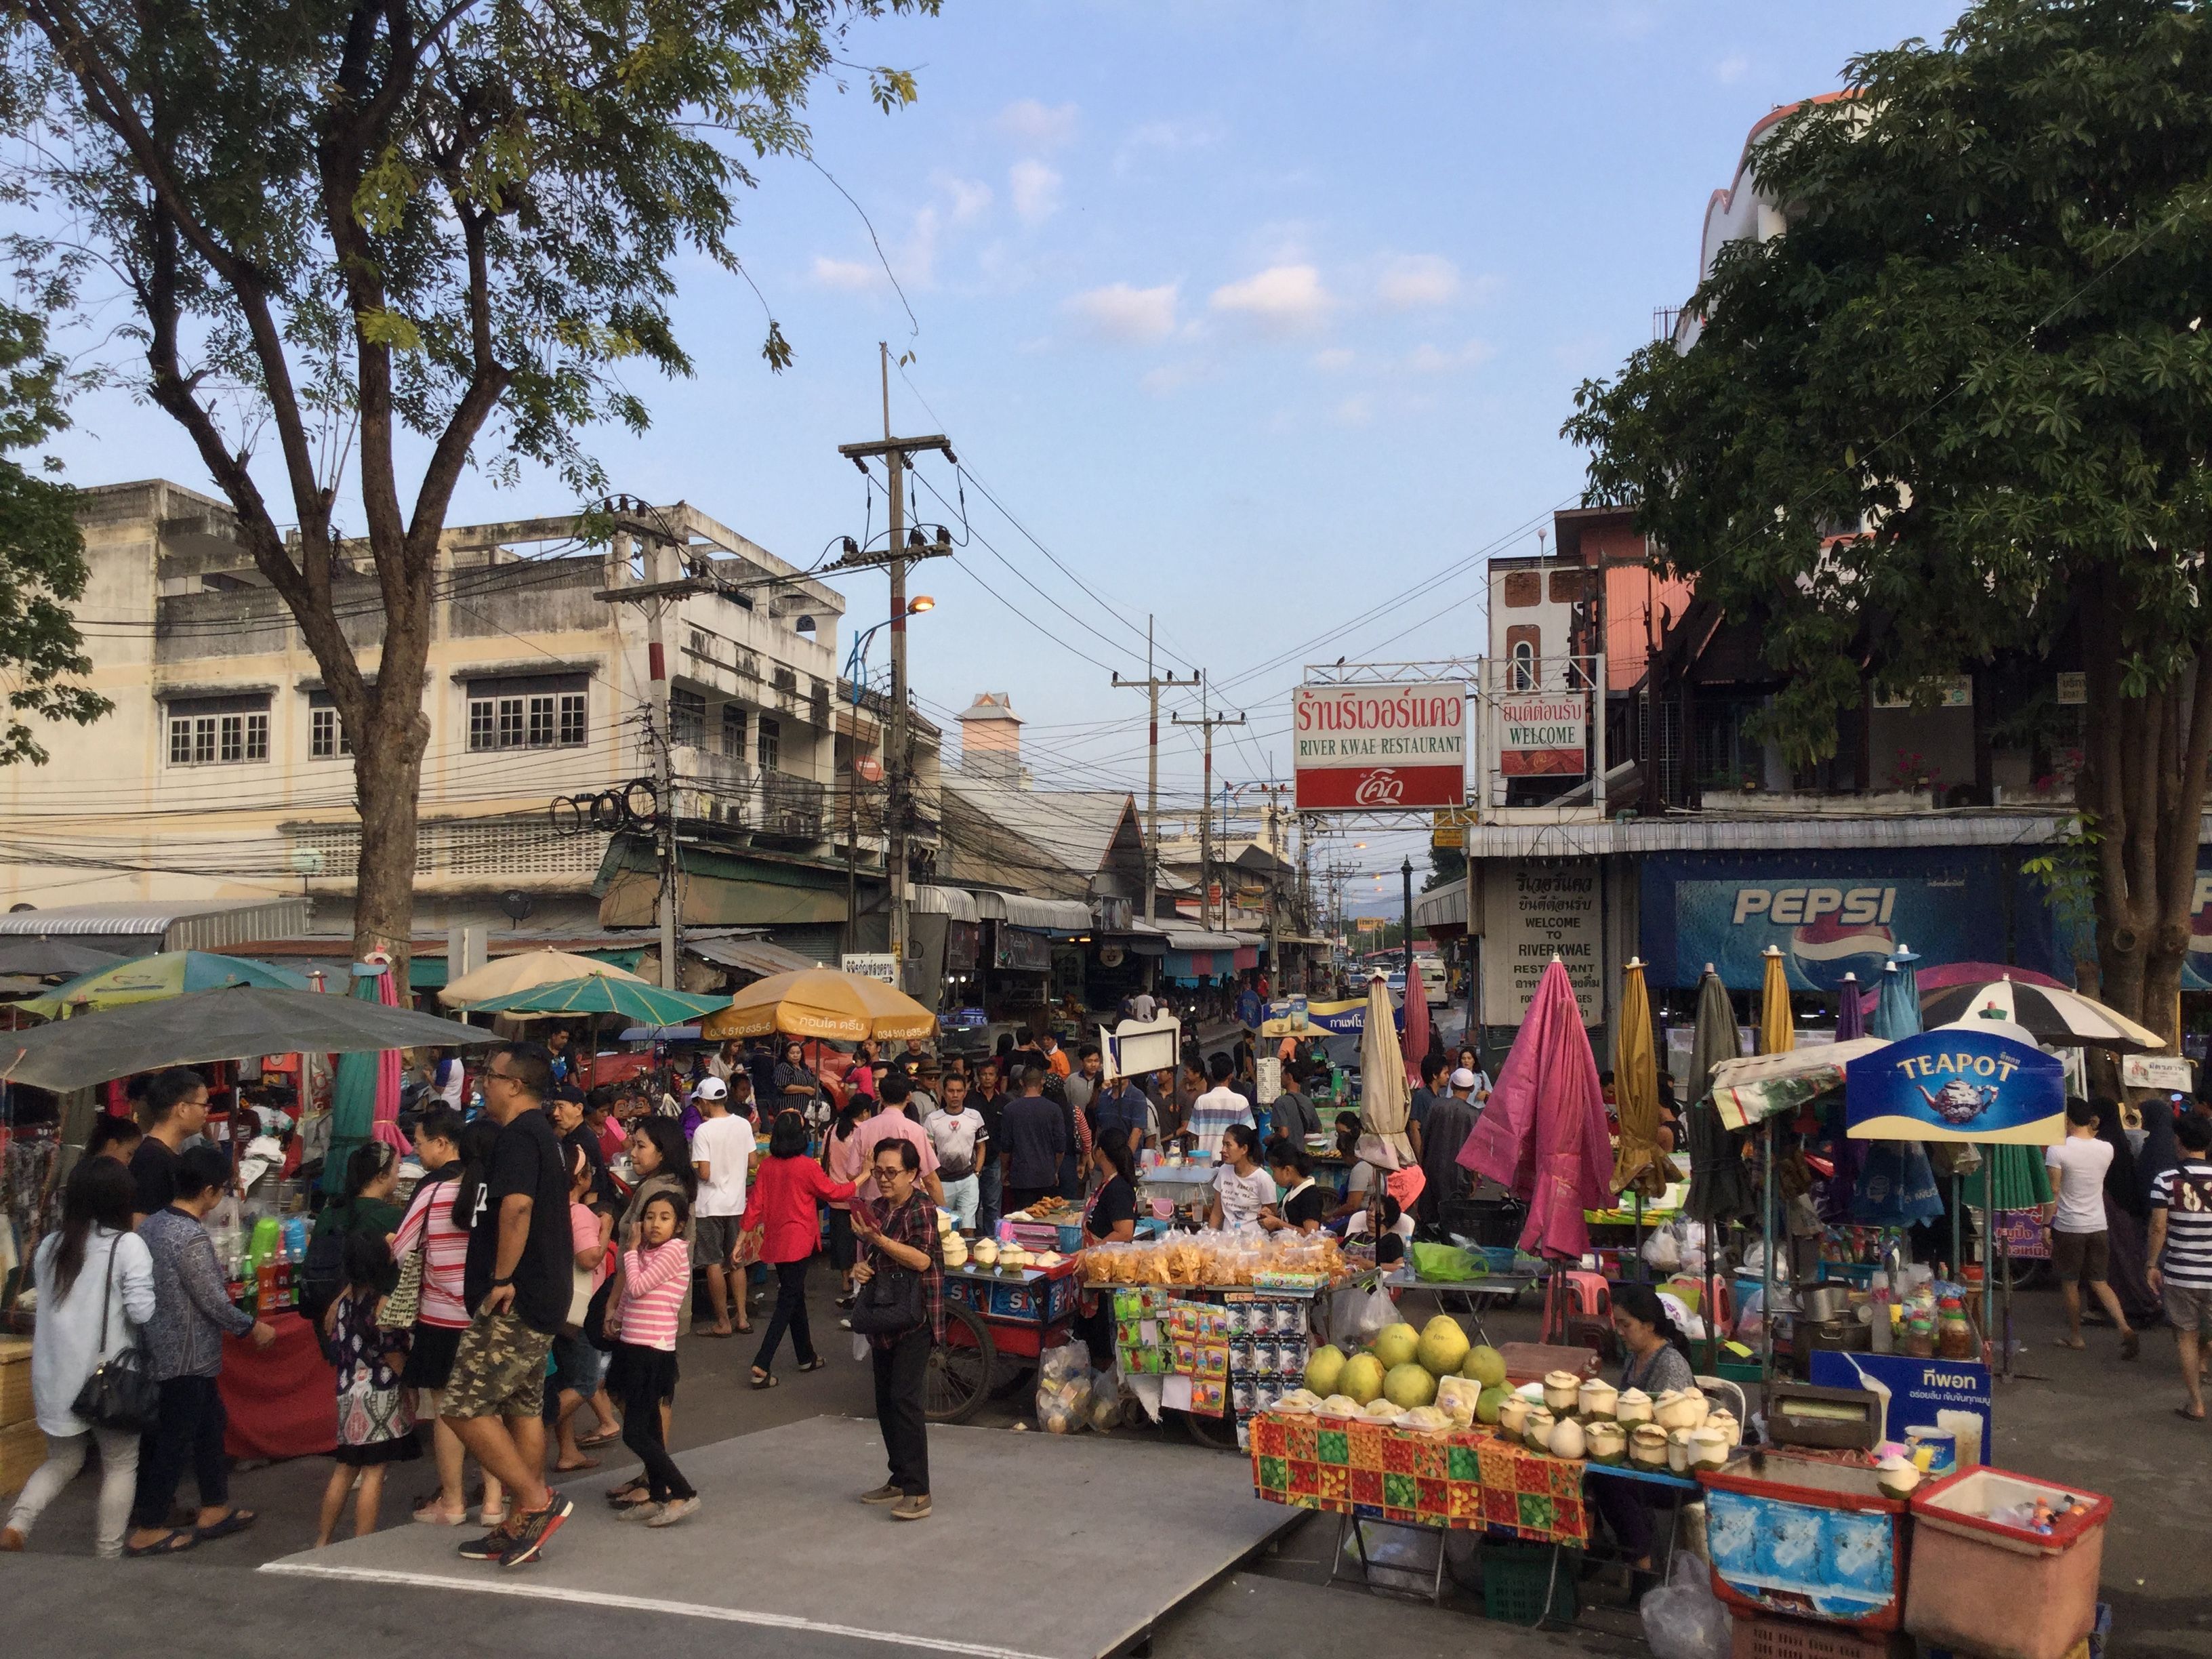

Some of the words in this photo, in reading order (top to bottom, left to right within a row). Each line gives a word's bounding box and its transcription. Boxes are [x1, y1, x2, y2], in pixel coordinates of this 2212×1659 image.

[1298, 687, 1461, 731] ร้านริเวอร์แคว
[1503, 699, 1582, 722] ยินดีต้อนรับ
[1509, 726, 1576, 745] WELCOME
[1300, 739, 1336, 756] RIVER
[1340, 738, 1376, 755] KWAE
[1381, 736, 1462, 754] RESTAURANT
[1732, 887, 1896, 925] PEPSI
[1525, 918, 1581, 928] WELCOME
[1546, 931, 1562, 940] TO
[1519, 944, 1555, 957] RIVER
[1557, 943, 1591, 957] KWAE
[1513, 964, 1595, 974] RESTRANT
[799, 1017, 837, 1029] คอนโด
[839, 1019, 865, 1031] ดรีม
[1330, 1014, 1365, 1028] กาแฟโบ
[728, 1025, 745, 1036] 510
[745, 1022, 771, 1033] 635-6
[877, 1029, 892, 1040] 034
[893, 1029, 905, 1038] 510
[905, 1027, 932, 1038] 635-6
[1896, 1053, 2020, 1083] TEAPOT
[1923, 1369, 1976, 1389] ทีพอท
